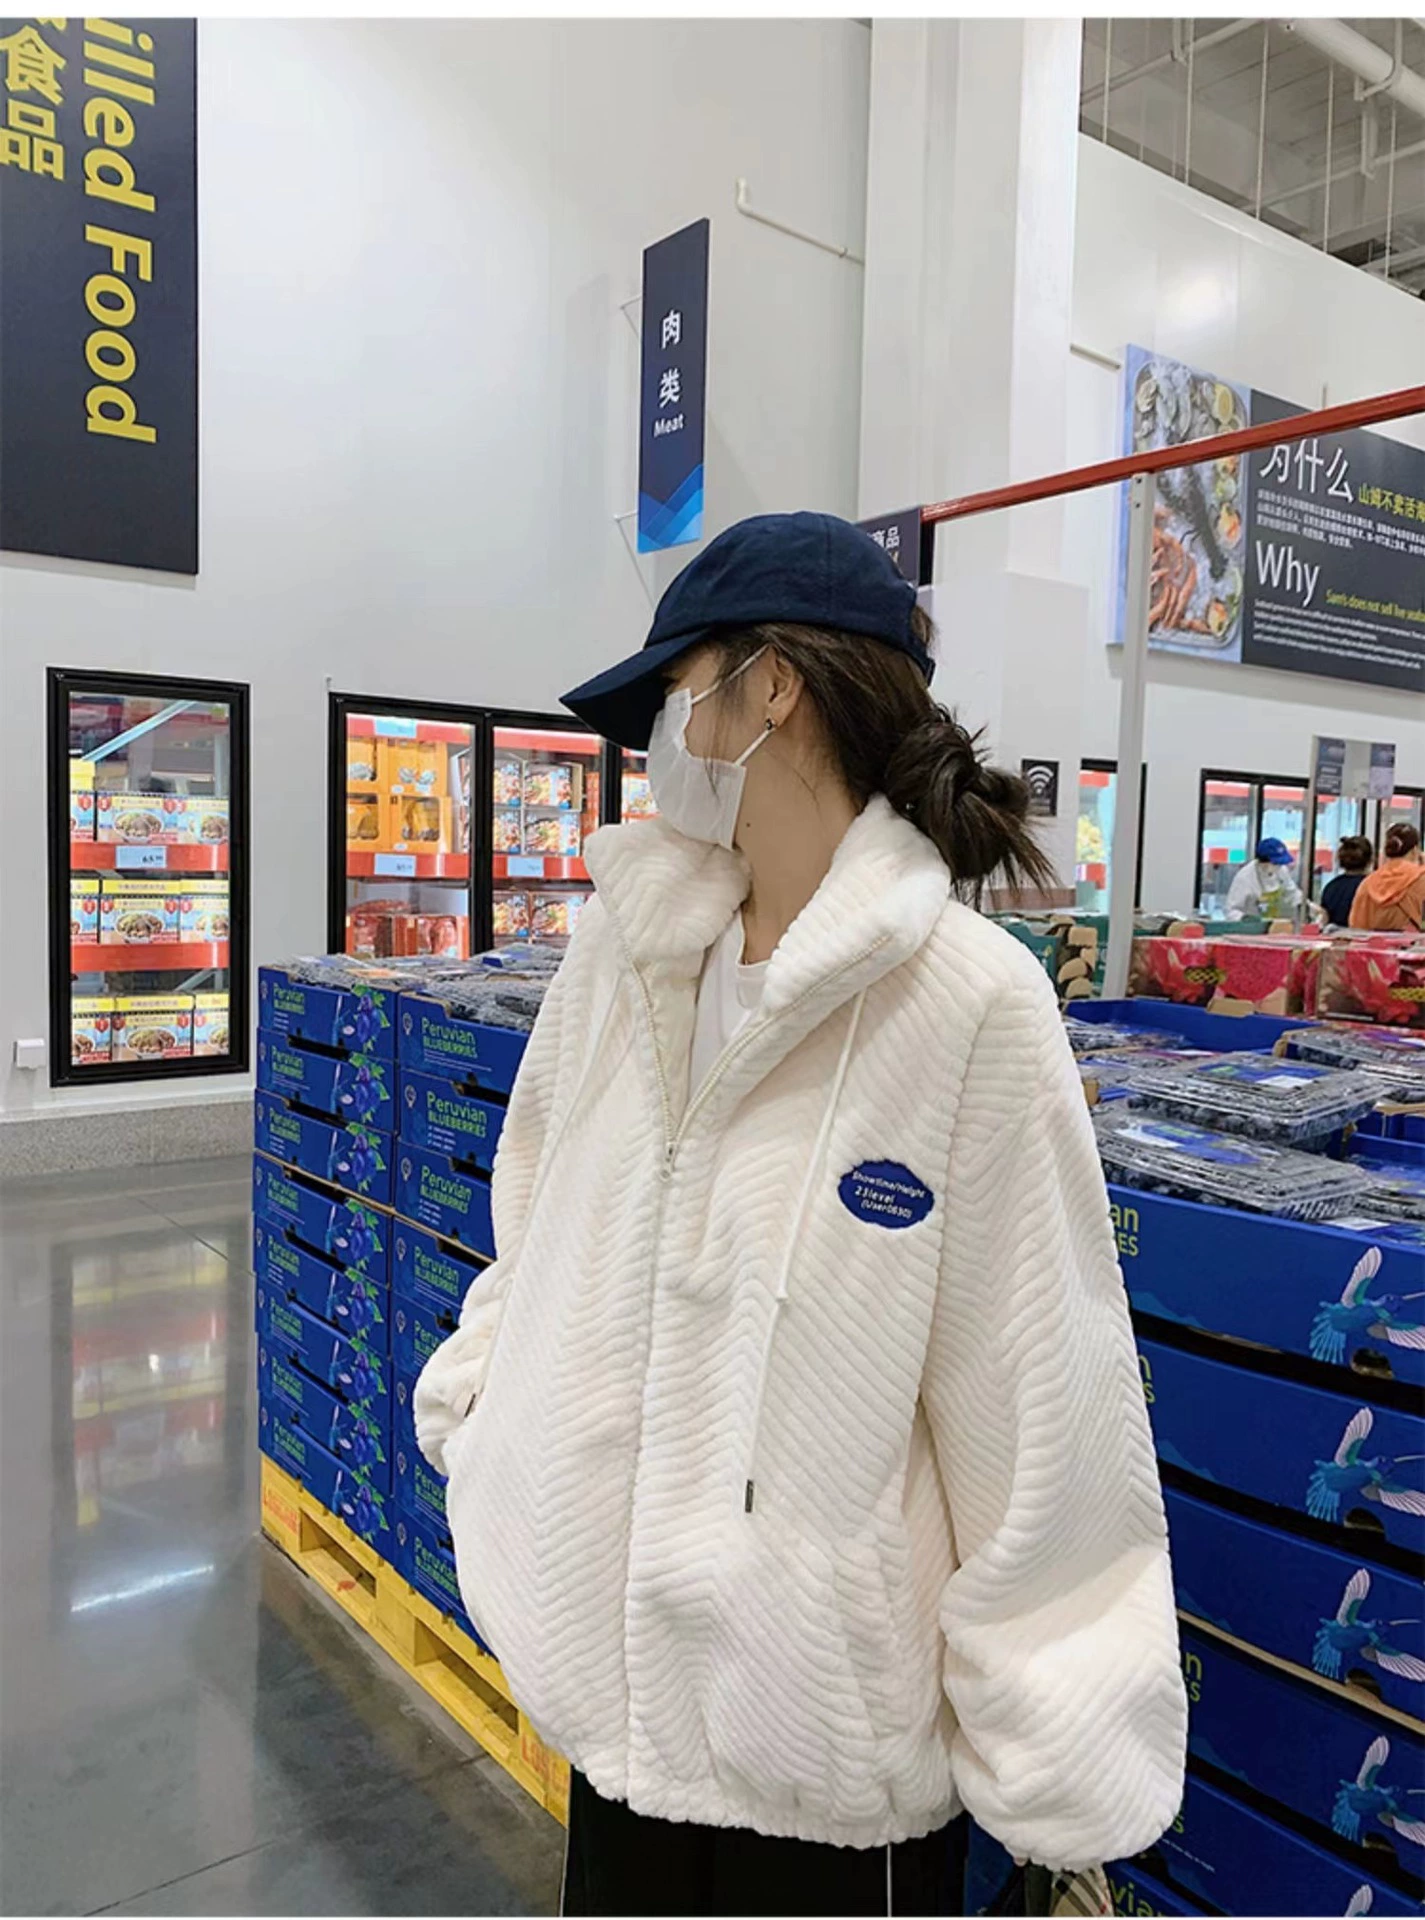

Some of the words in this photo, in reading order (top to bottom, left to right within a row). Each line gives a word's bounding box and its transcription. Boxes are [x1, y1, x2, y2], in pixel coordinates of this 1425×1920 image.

[0, 17, 67, 181] 食品
[85, 223, 157, 443] Food
[659, 308, 682, 409] 肉类
[653, 413, 685, 438] Meat
[1259, 437, 1353, 503] 为什么
[1255, 540, 1320, 607] Why
[422, 1017, 476, 1045] Peruvian
[427, 1091, 488, 1124] Peruvian
[428, 1110, 487, 1138] BLUEBERRIES
[421, 1165, 473, 1202] Peruvian
